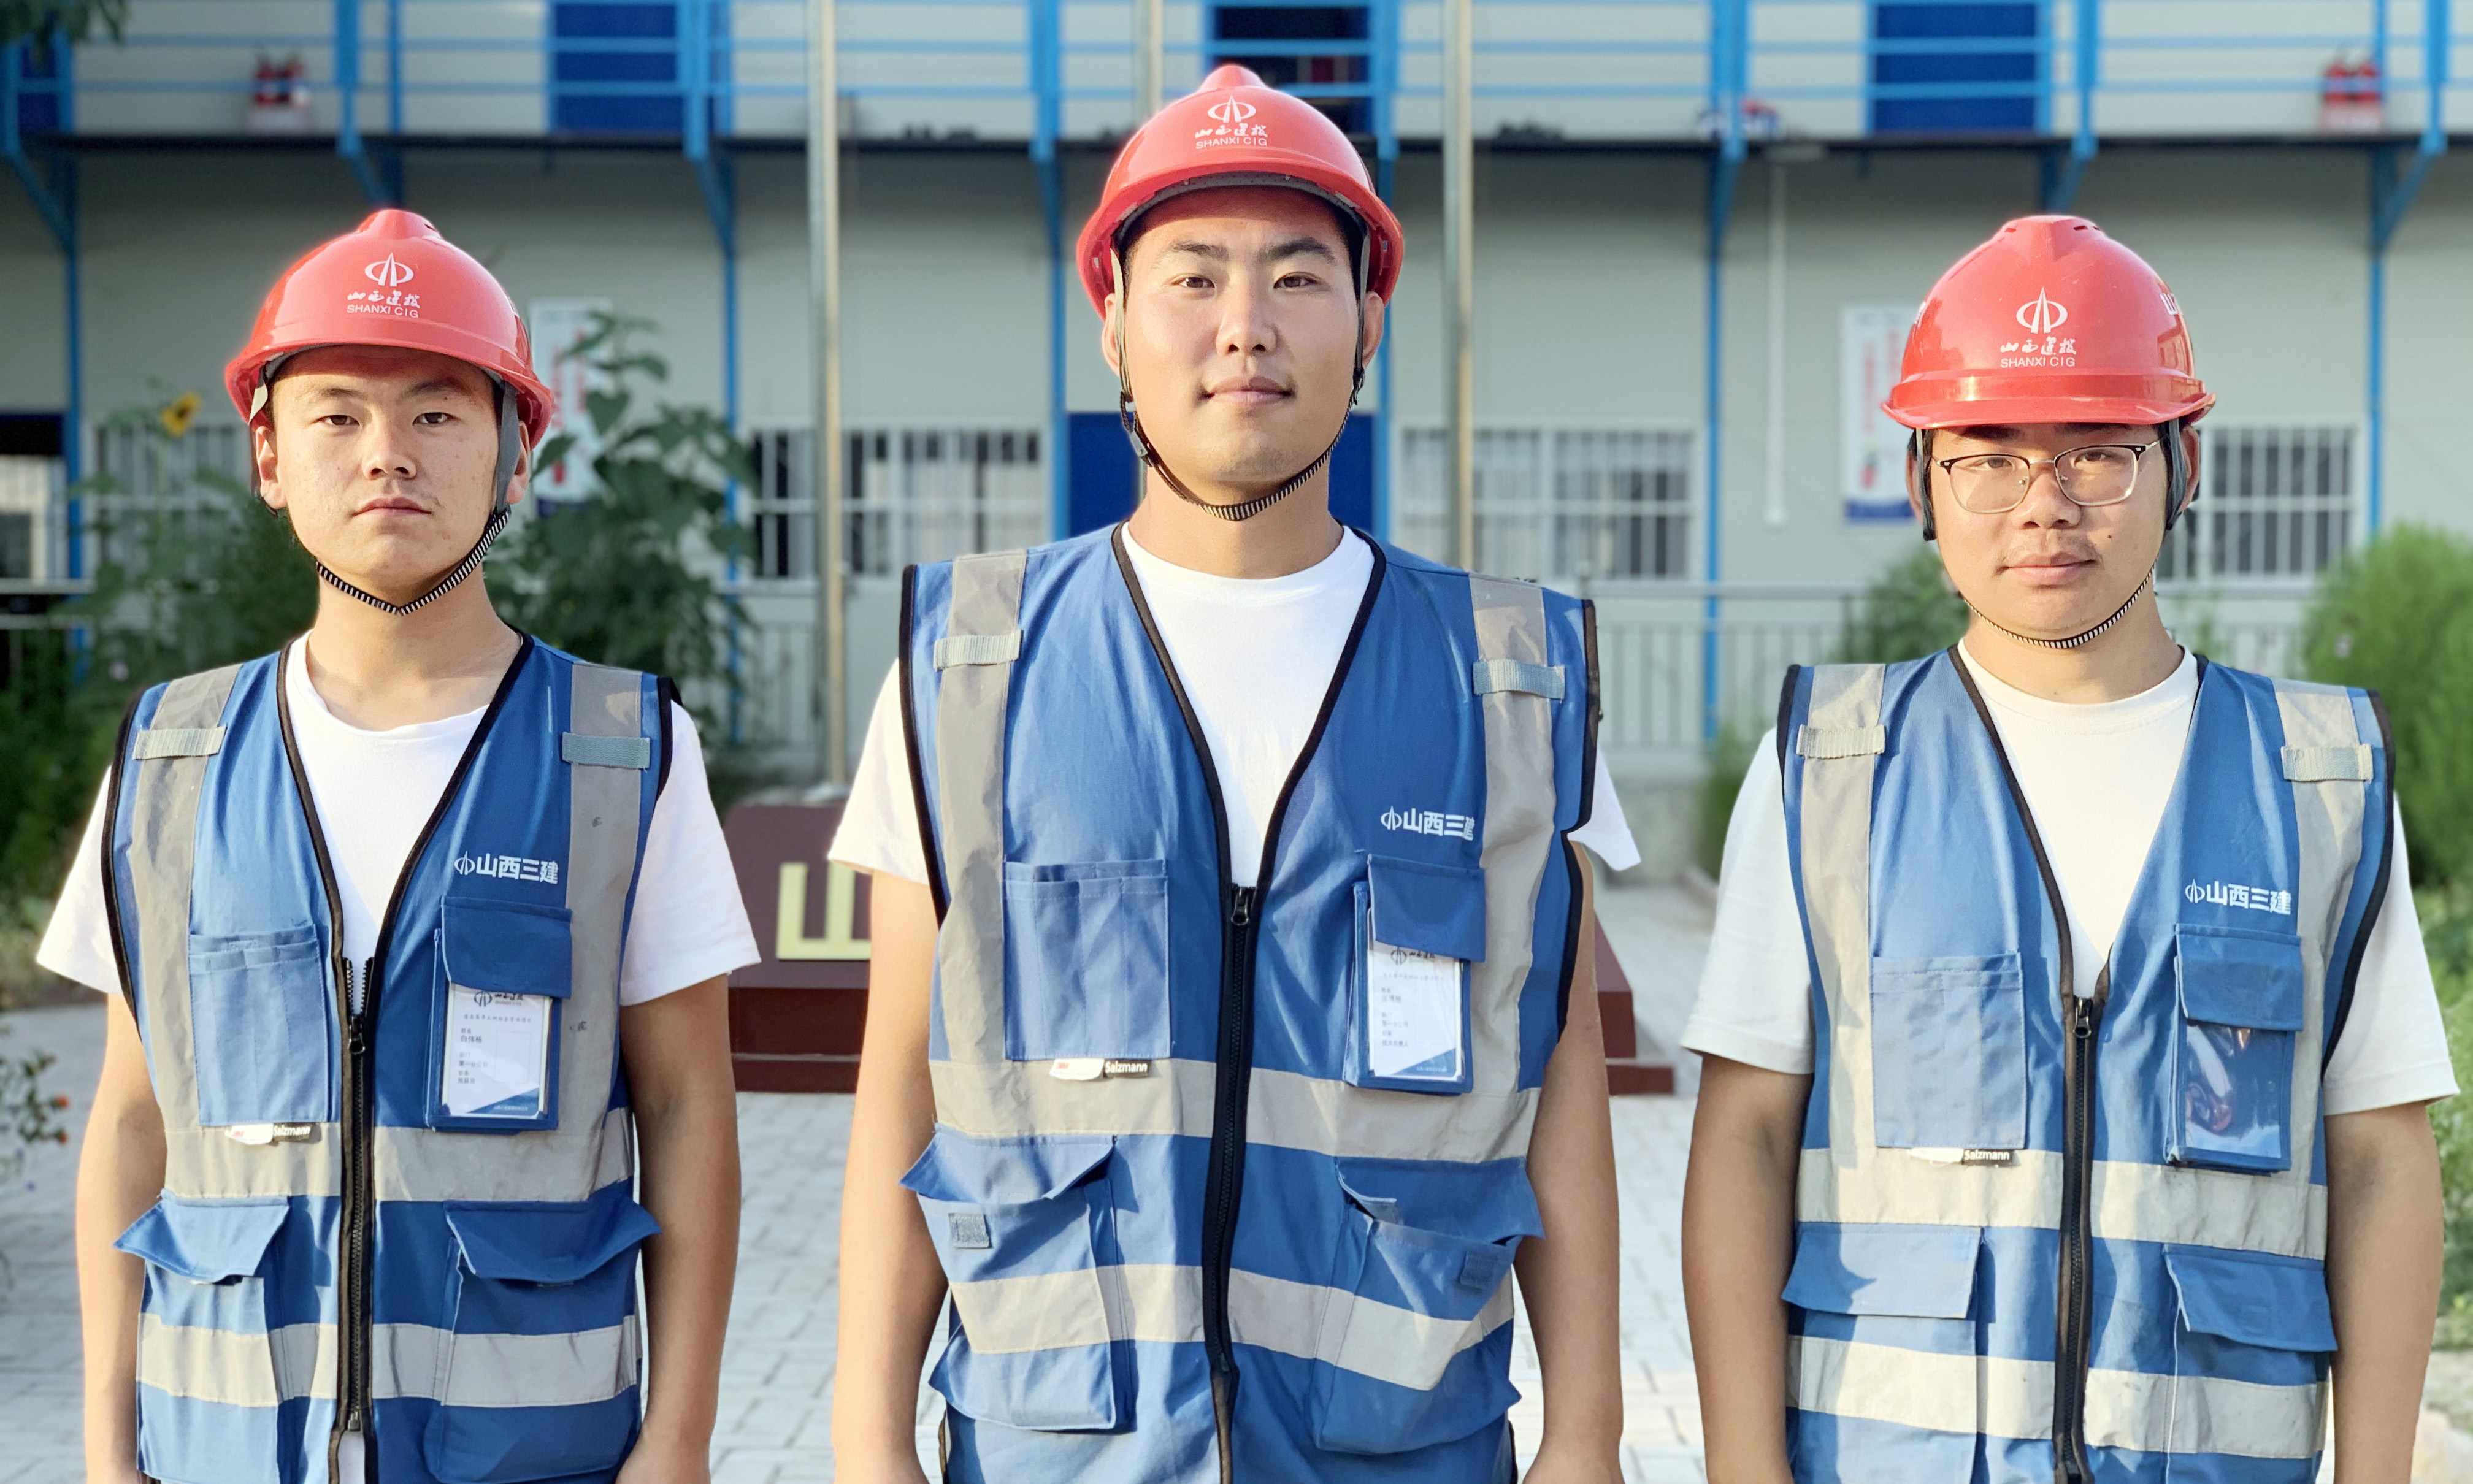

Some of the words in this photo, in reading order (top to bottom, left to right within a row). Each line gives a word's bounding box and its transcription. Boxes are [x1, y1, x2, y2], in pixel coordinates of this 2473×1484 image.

[1195, 123, 1268, 139] 山西建投
[1195, 137, 1240, 150] SHANXI
[1243, 137, 1267, 147] CIG
[347, 289, 420, 308] 山西建投
[347, 304, 391, 315] SHANXI
[394, 307, 418, 318] CIG
[2000, 335, 2077, 355] 山西建投
[2000, 356, 2046, 368] SHANXI
[2050, 356, 2076, 367] CIG
[475, 853, 559, 884] 山西三建
[2206, 881, 2292, 915] 山西三建
[1105, 1060, 1148, 1073] Salzmann
[274, 1124, 311, 1136] Salzmann
[1965, 1149, 2010, 1160] Salzmann
